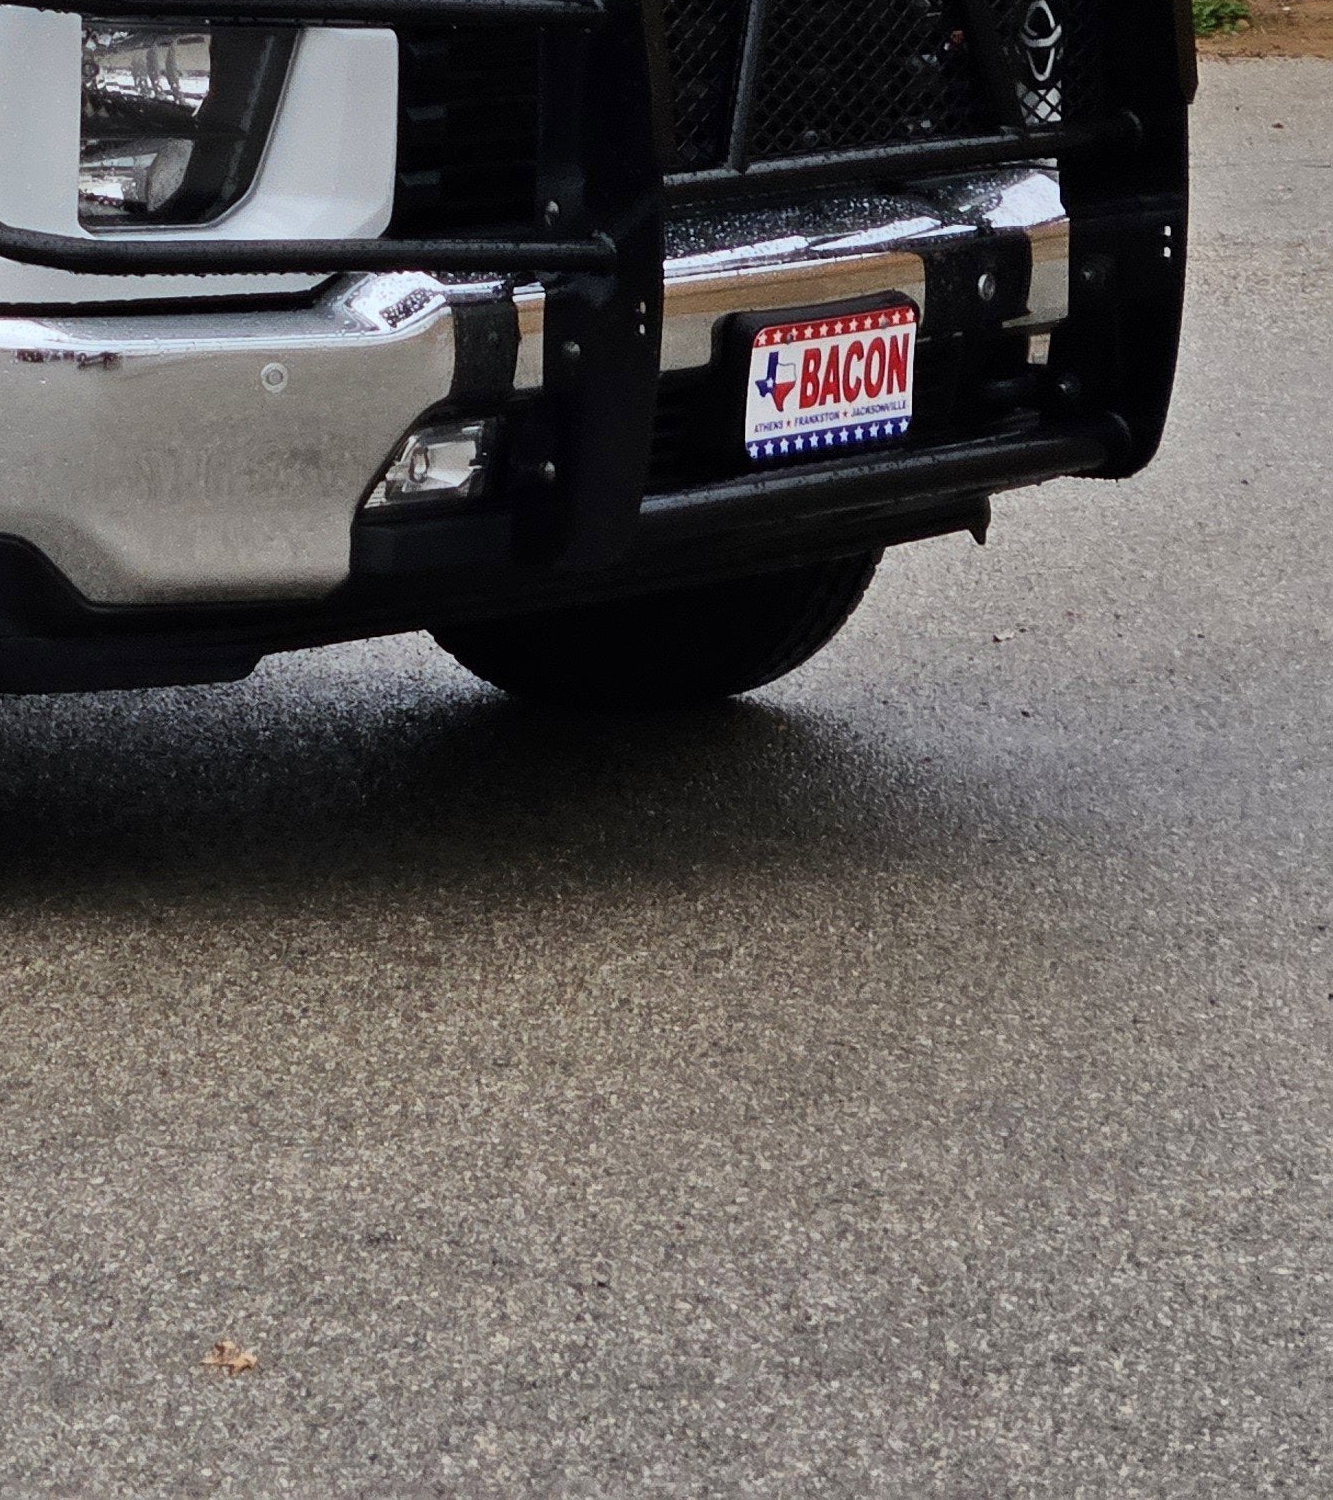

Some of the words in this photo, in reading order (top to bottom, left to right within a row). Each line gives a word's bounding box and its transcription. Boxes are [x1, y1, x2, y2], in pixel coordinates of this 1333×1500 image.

[799, 332, 911, 409] BACON
[753, 420, 784, 434] ATHENS
[794, 410, 840, 427] FRANKSTON
[851, 399, 907, 418] JACKSONVILLE
